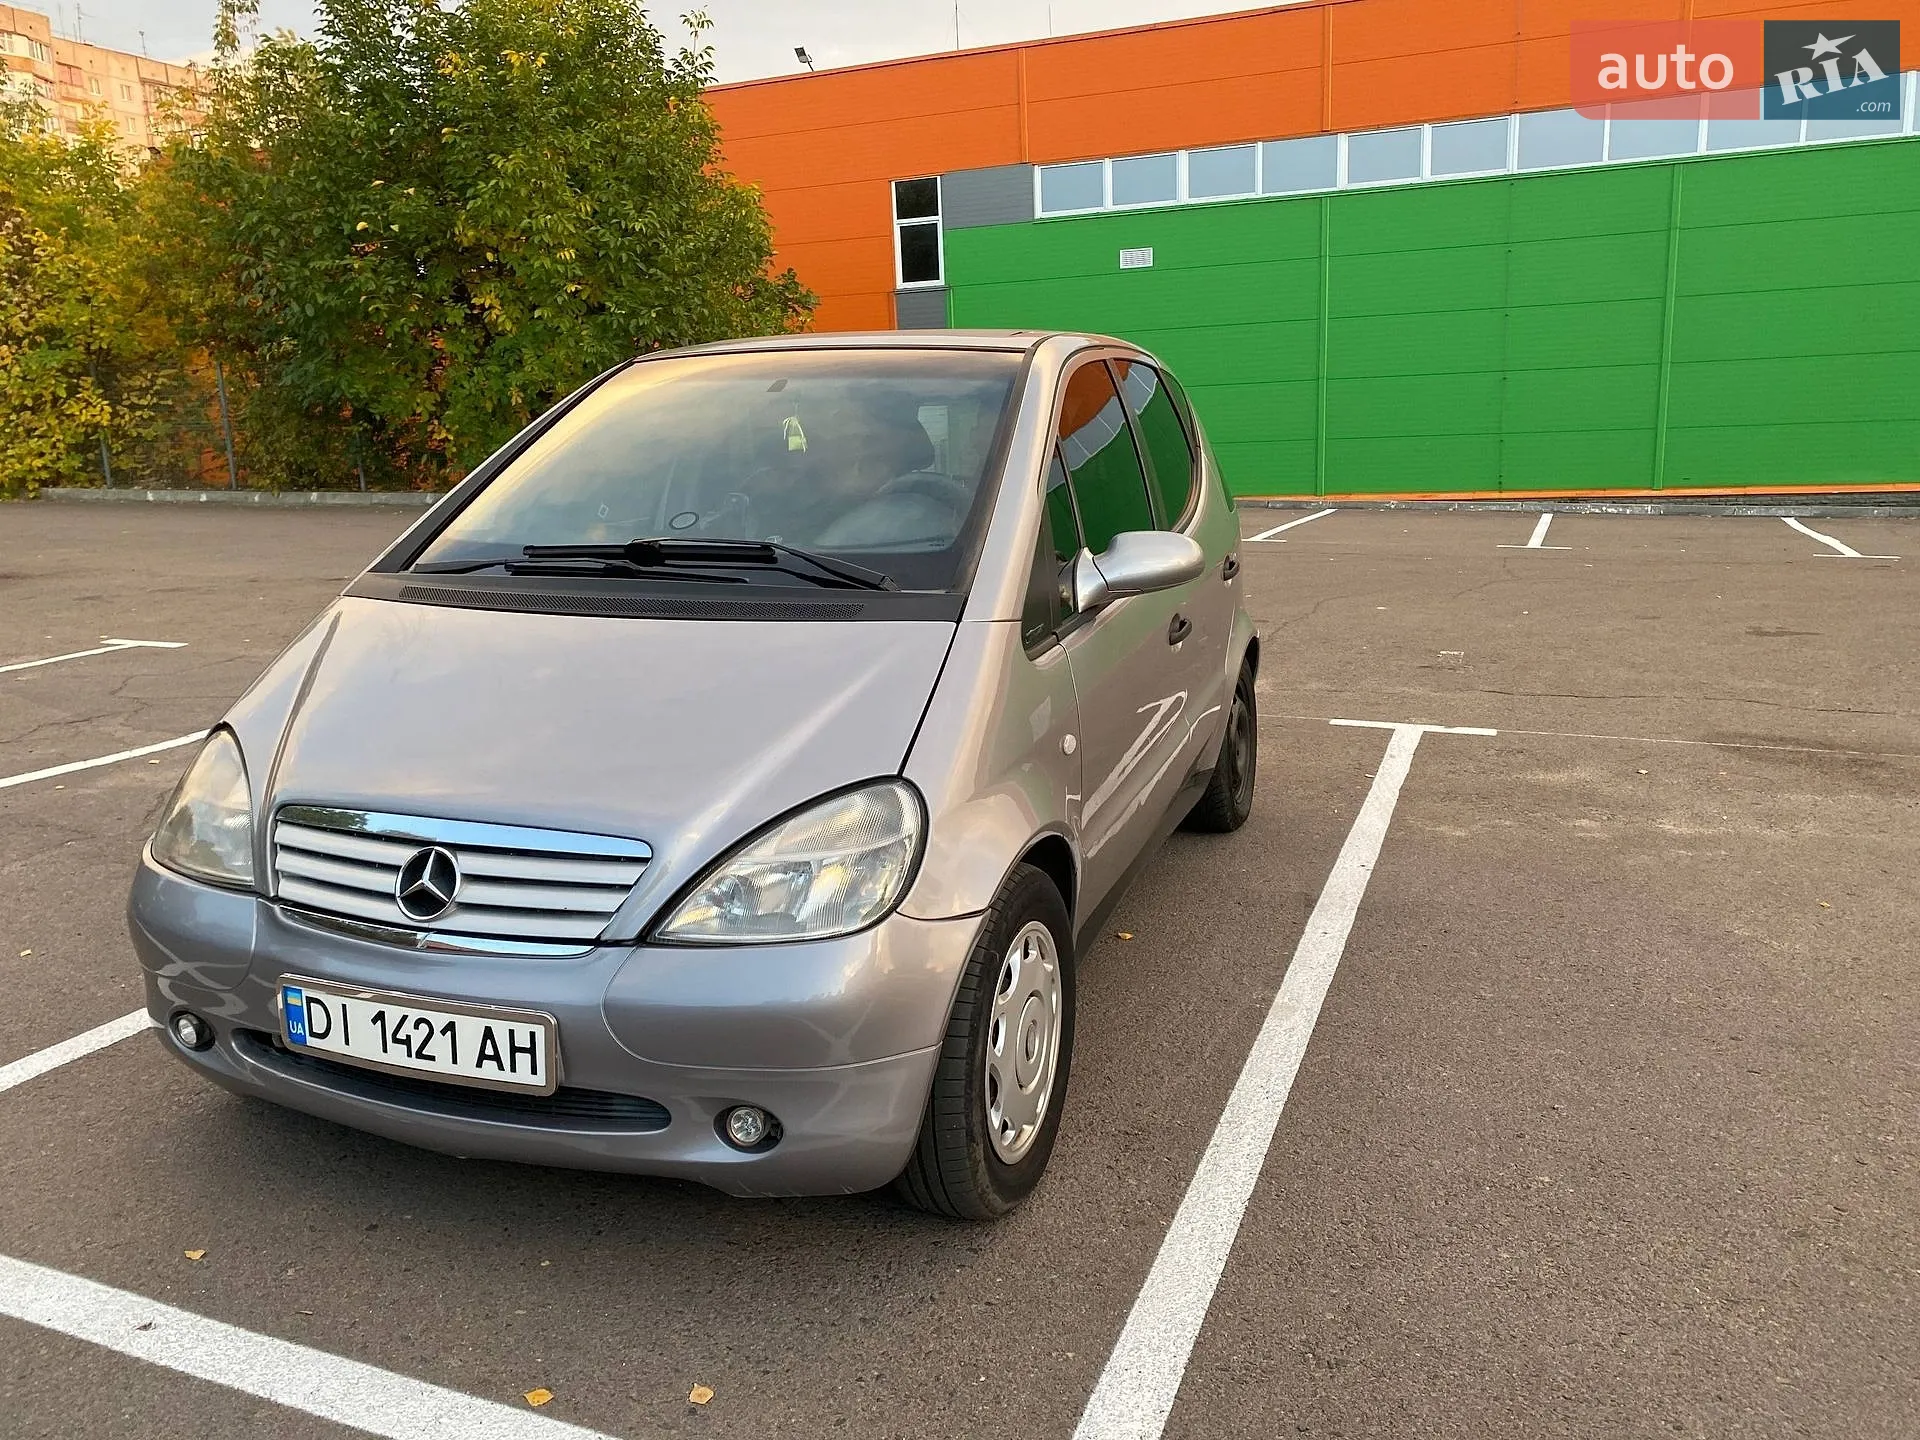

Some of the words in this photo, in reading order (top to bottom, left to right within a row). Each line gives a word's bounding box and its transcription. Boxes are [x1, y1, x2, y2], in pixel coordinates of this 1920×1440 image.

[289, 1020, 304, 1035] UA
[305, 996, 350, 1046] DI
[371, 1010, 458, 1065] 1421
[475, 1025, 538, 1076] AH
